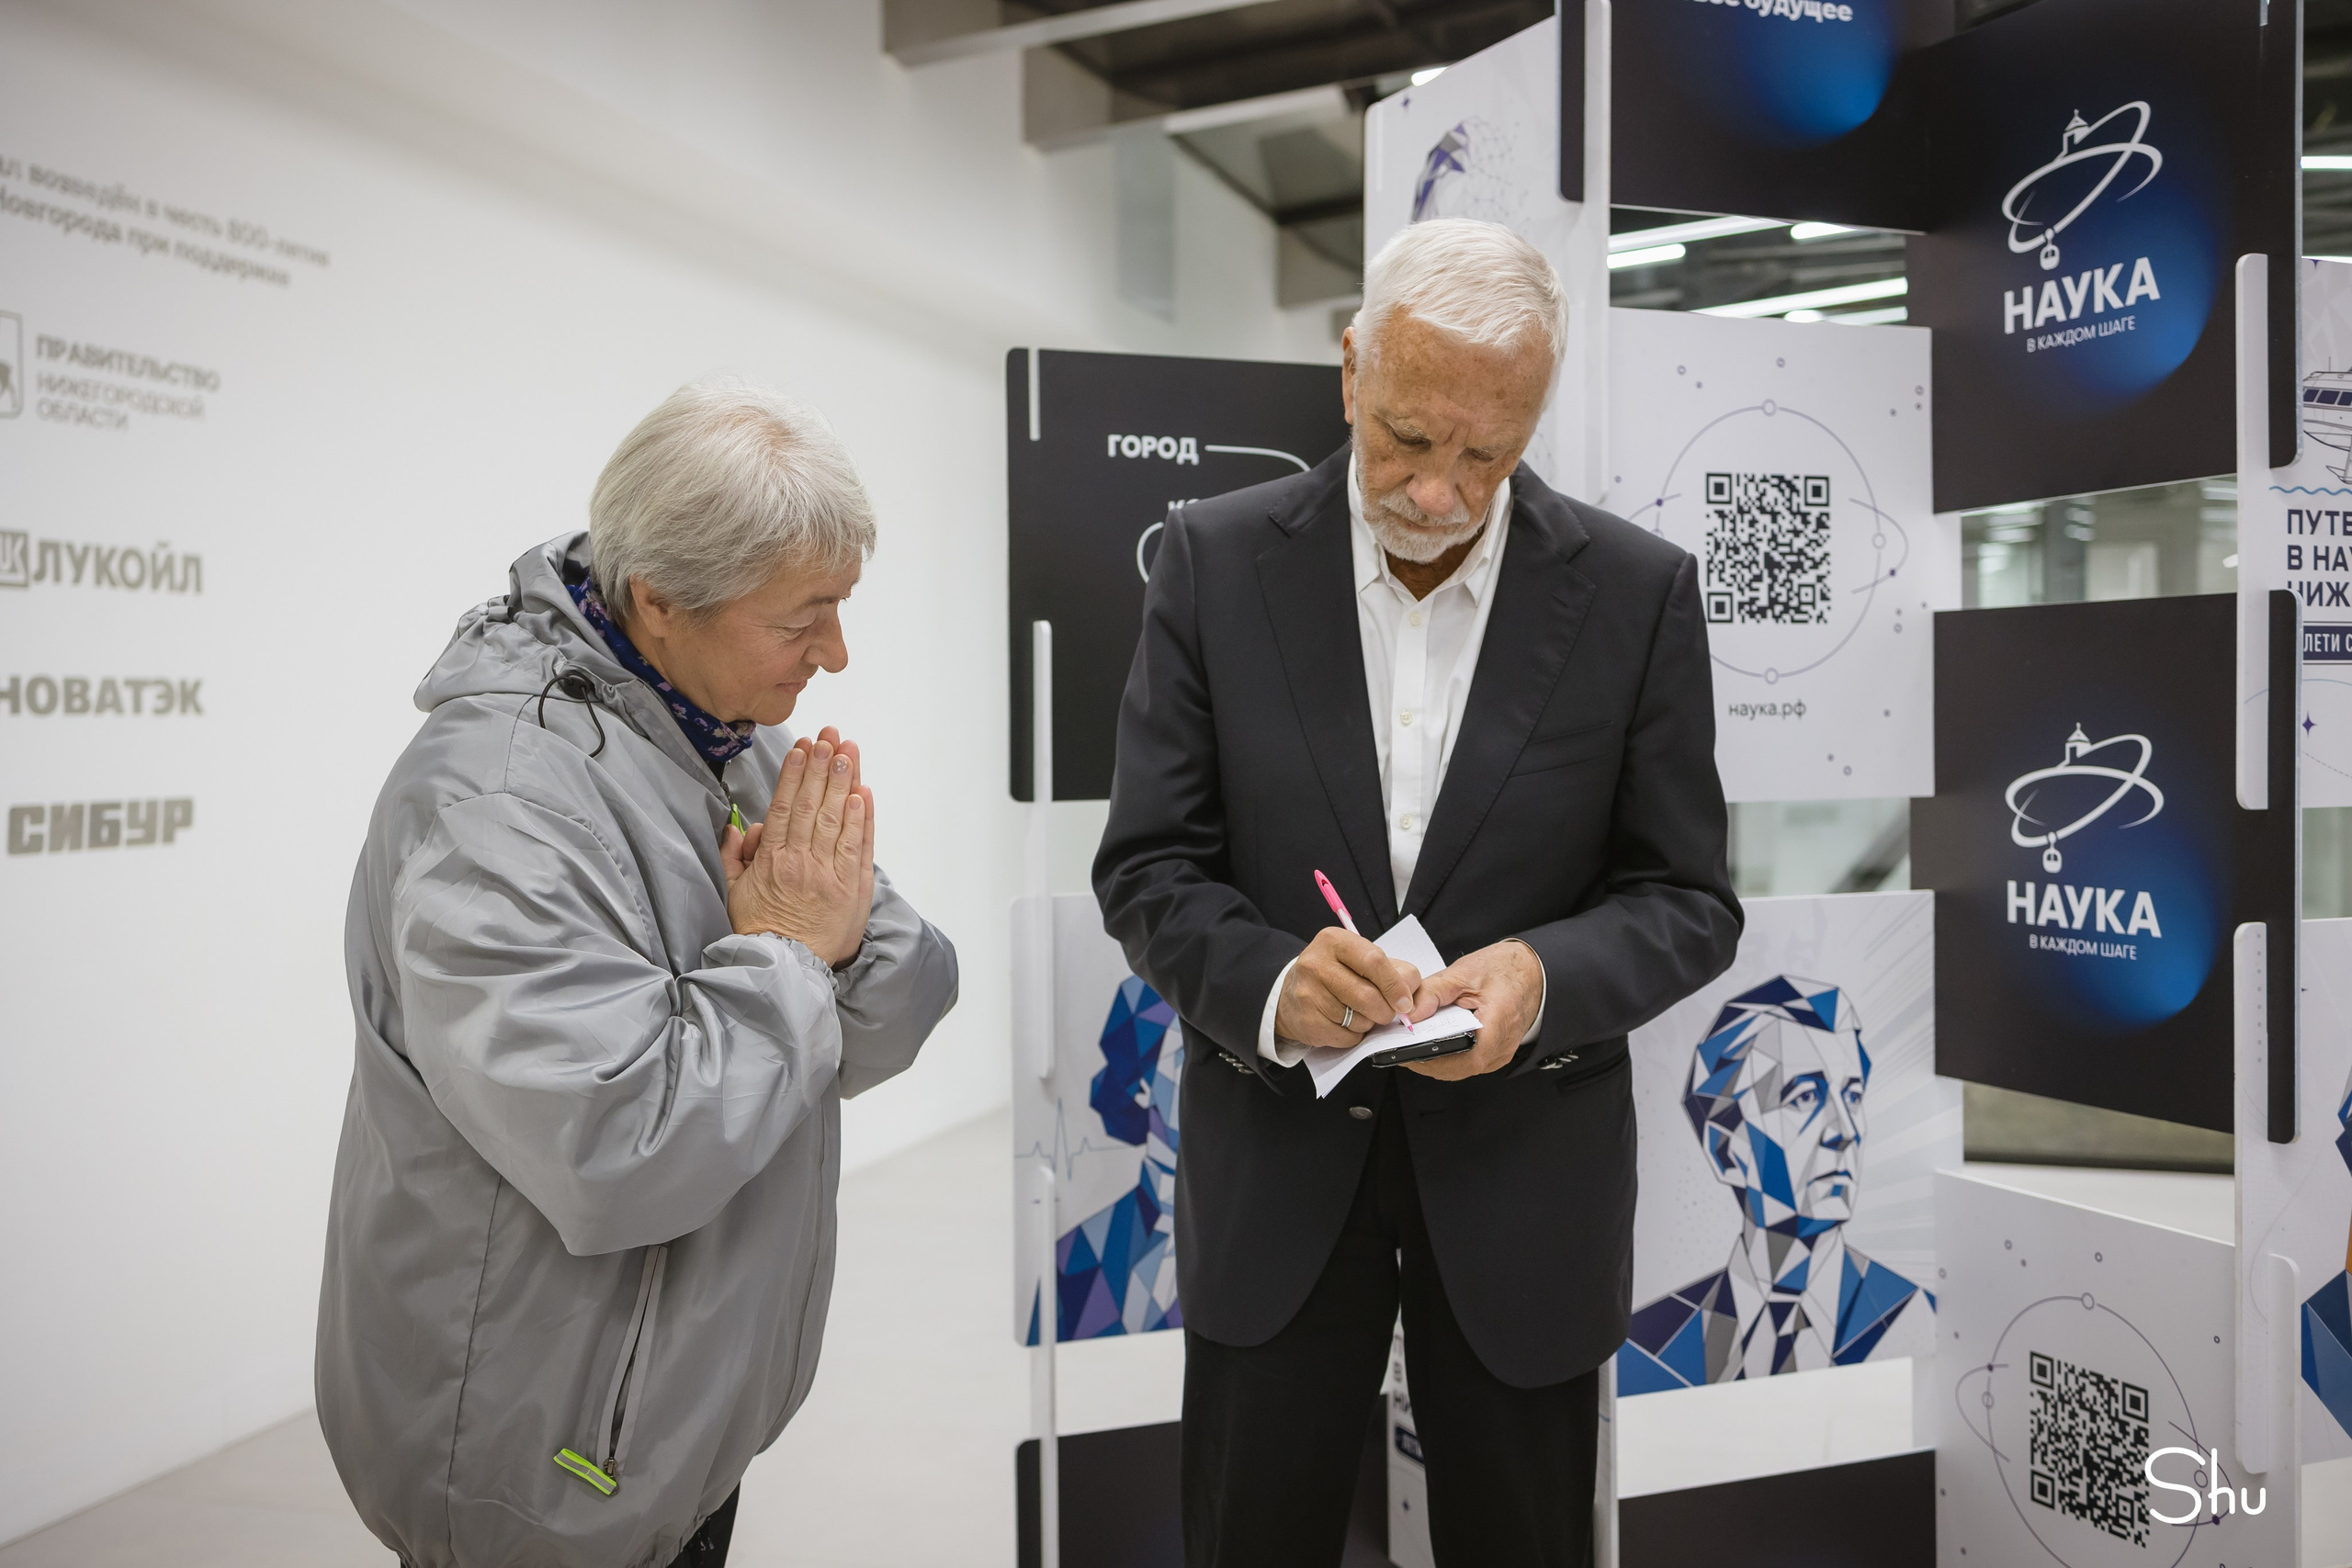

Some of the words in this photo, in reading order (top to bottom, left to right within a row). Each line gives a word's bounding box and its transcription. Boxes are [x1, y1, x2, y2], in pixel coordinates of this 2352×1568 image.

[2004, 256, 2161, 335] НАУКА
[2027, 337, 2037, 354] В
[2037, 323, 2096, 350] КАЖДОМ
[2098, 315, 2136, 337] ШАГЕ
[36, 333, 221, 392] ПРАВИТЕЛЬСТВО
[1107, 434, 1199, 465] ГОРОД
[2287, 509, 2352, 536] ПУТЕ
[34, 539, 202, 594] ЛУКОЙЛ
[2287, 544, 2302, 570] В
[2312, 545, 2352, 571] НА
[1728, 699, 1807, 721] наука.рф
[7, 797, 194, 855] СИБУР
[2007, 880, 2163, 939] НАУКА
[2029, 934, 2039, 949] В
[2040, 935, 2098, 956] КАЖДОМ
[2100, 942, 2137, 961] ШАГЕ
